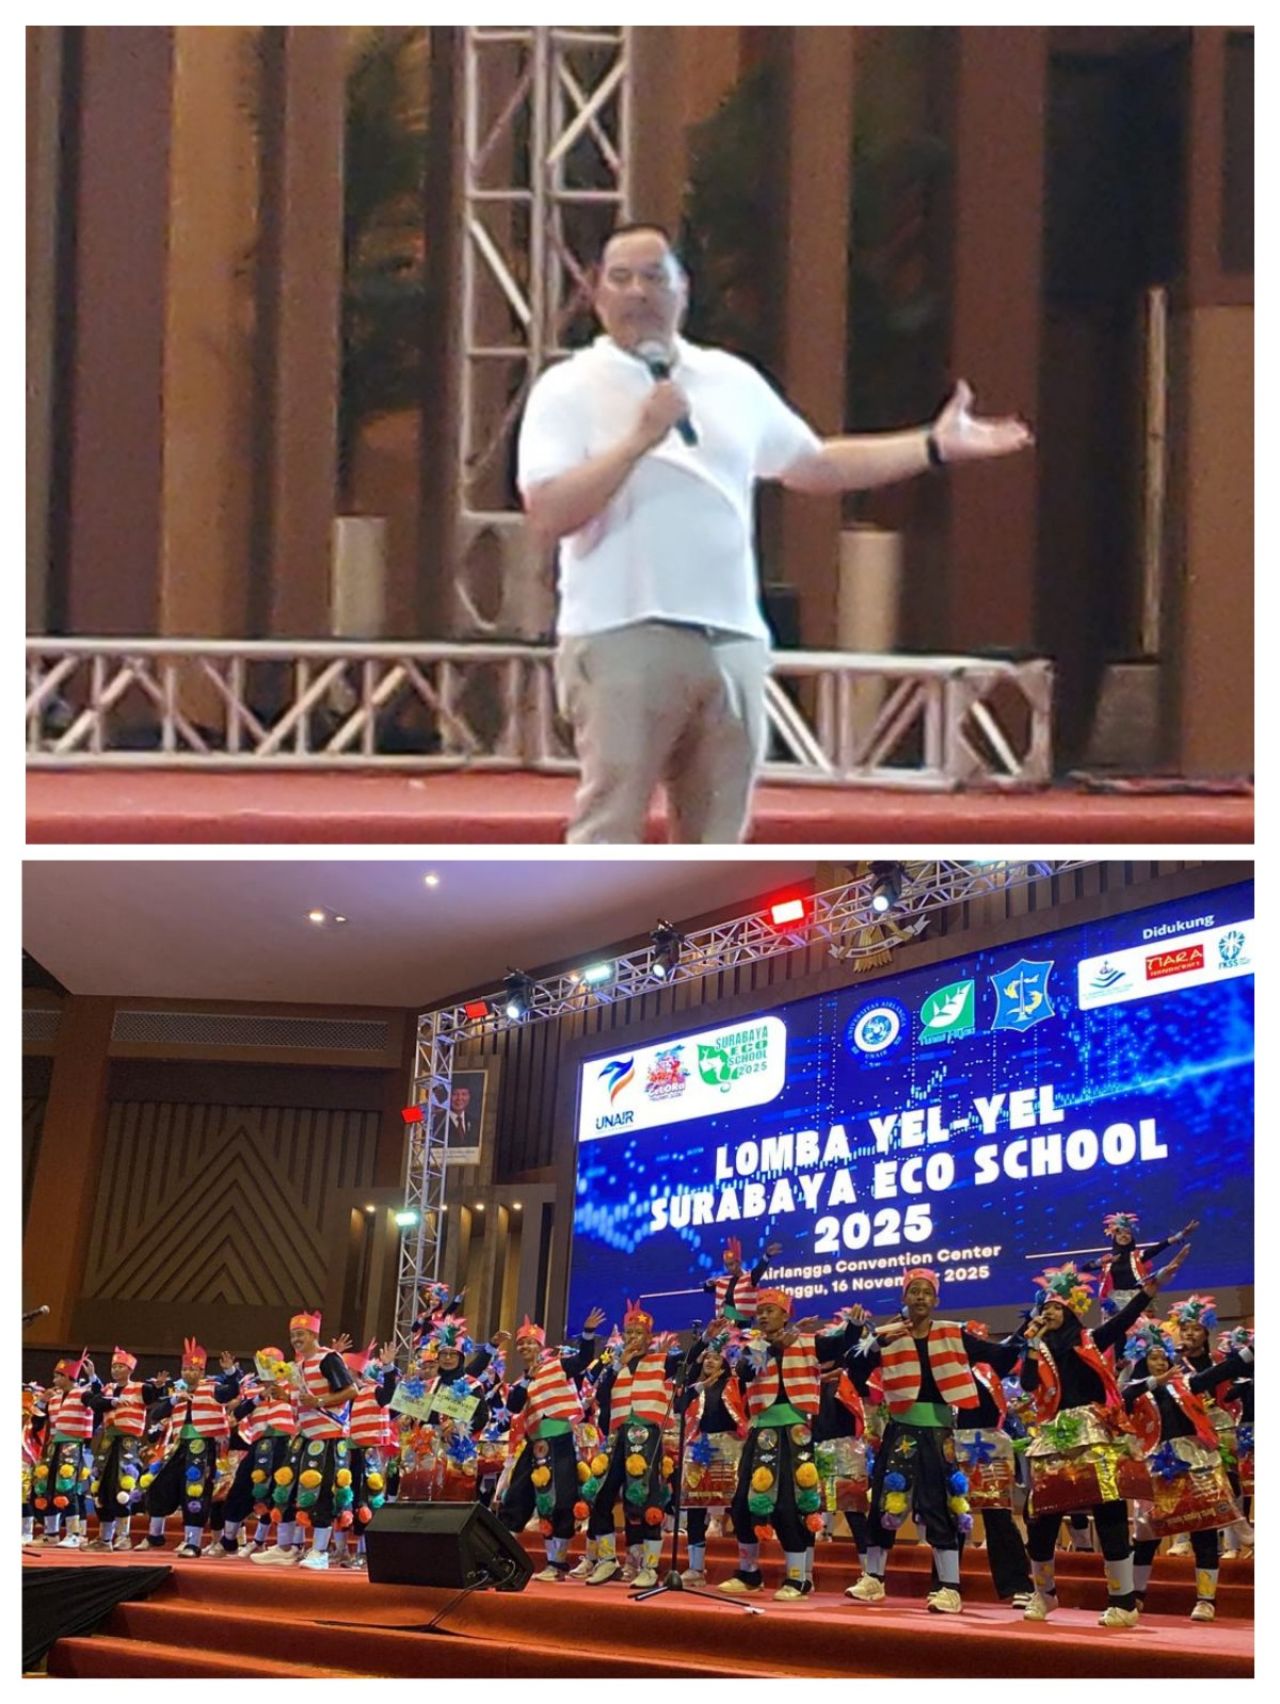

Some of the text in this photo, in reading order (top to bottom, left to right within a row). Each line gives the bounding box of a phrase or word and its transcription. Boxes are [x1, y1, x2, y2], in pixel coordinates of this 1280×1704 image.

[1143, 915, 1215, 940] Didukung
[1147, 949, 1202, 970] TIARA
[716, 1025, 768, 1049] SURABAYA
[729, 1049, 767, 1066] SCHOOL
[739, 1061, 767, 1076] 2025
[596, 1110, 634, 1130] UNAIR
[716, 1084, 1065, 1180] LOMBA YEL-YEL
[650, 1118, 1168, 1232] SURABAYA ECO SCHOOL
[814, 1203, 934, 1253] 2025
[760, 1245, 1001, 1281] Airlangga Convention Center
[768, 1284, 829, 1299] inggu,
[832, 1279, 849, 1293] 16
[944, 1266, 990, 1282] 2025
